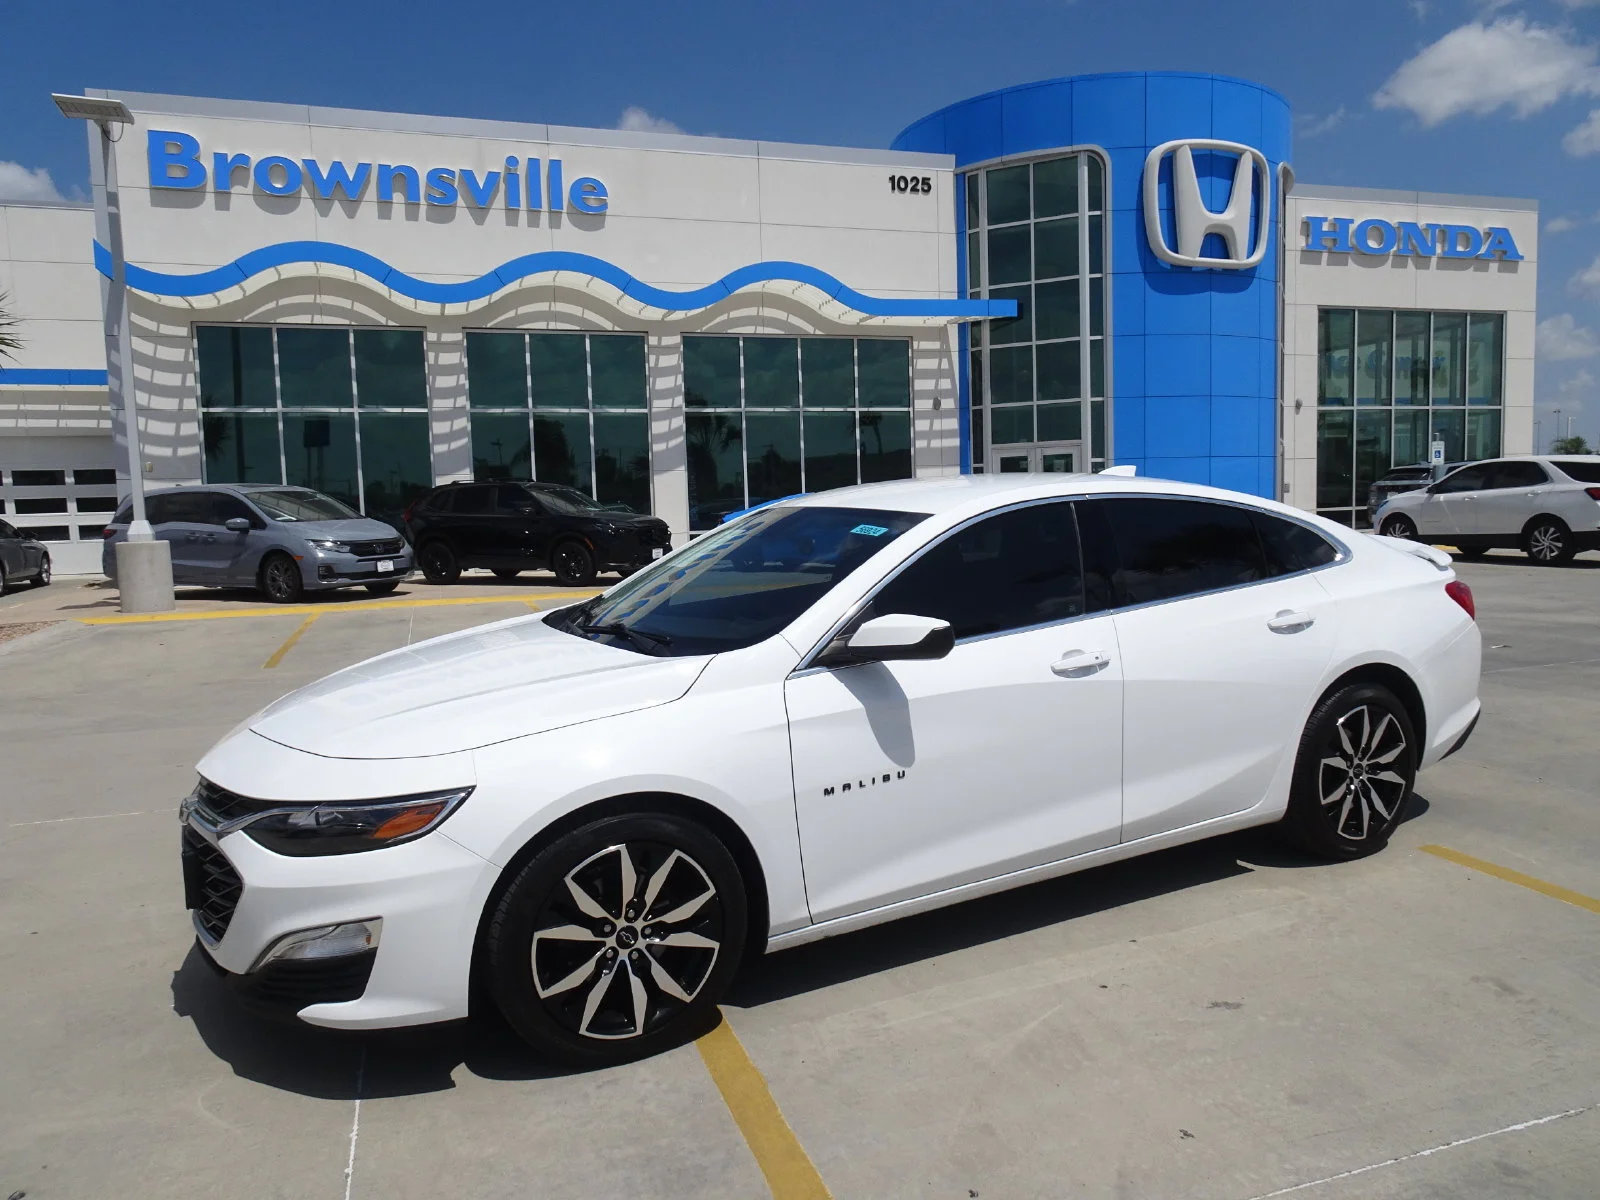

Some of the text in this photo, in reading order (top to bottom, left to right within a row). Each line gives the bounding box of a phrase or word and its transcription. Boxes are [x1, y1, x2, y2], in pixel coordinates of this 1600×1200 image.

[147, 129, 609, 214] Brownsville
[888, 174, 932, 193] 1025
[1304, 215, 1525, 261] HONDA
[823, 769, 906, 797] MALIBU
